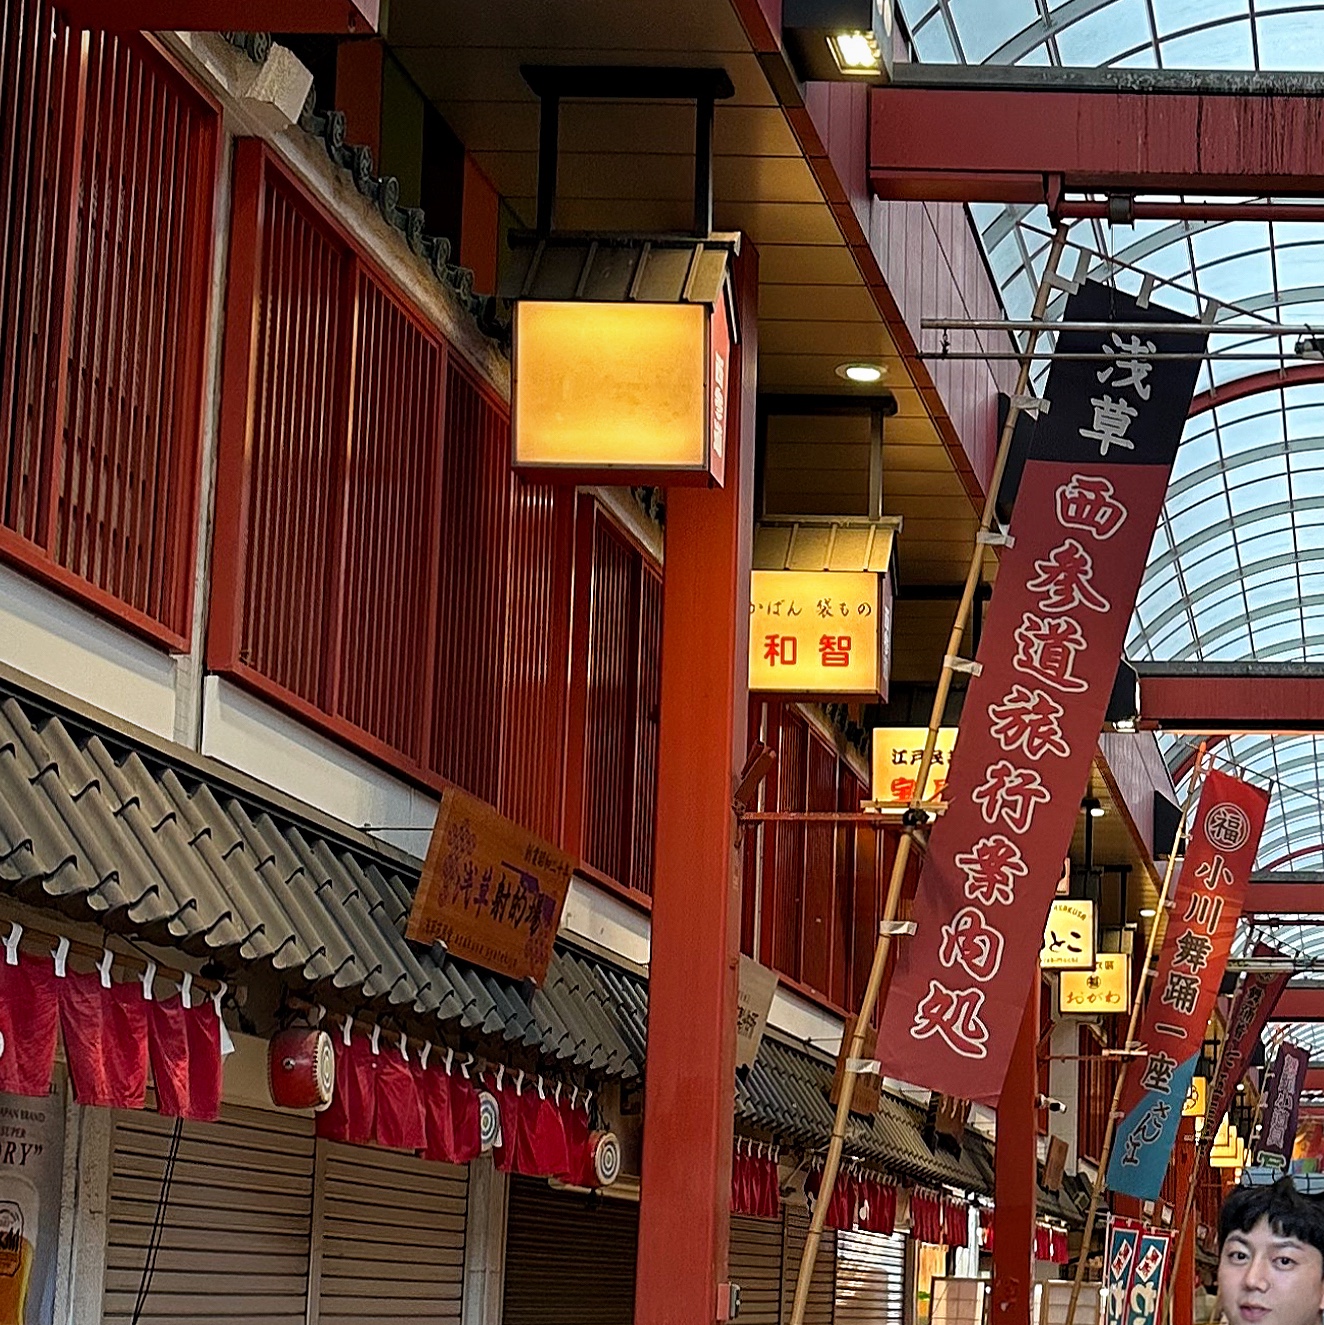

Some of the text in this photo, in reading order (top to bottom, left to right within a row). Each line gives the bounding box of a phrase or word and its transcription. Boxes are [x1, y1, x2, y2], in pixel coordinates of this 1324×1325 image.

[816, 598, 873, 618] 袋もの
[763, 633, 853, 668] 和智
[1140, 855, 1236, 1095] 小川舞踊一座
[1120, 1099, 1172, 1167] さん江
